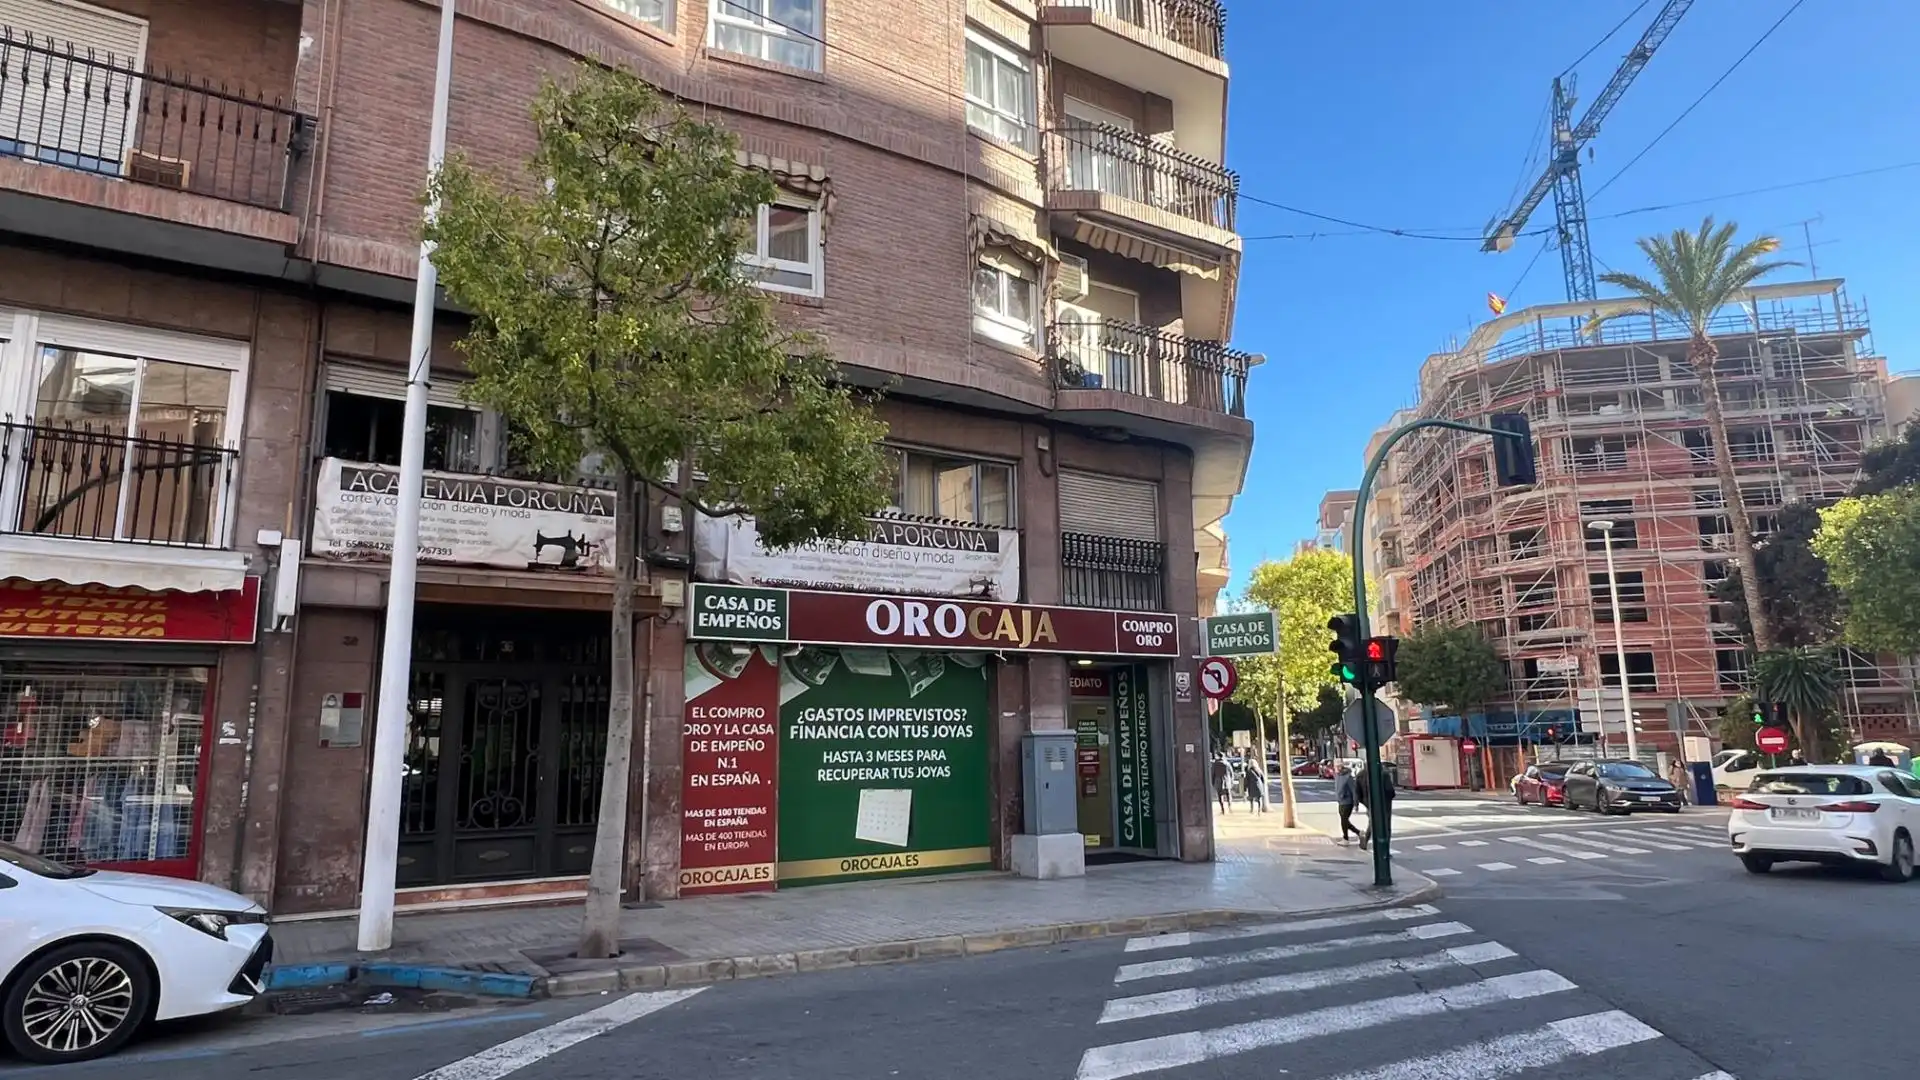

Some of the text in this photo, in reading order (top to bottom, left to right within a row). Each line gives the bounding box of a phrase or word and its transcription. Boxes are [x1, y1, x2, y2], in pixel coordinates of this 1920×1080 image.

[349, 470, 606, 515] ACAEMIA PORCUNA
[340, 492, 372, 504] corte
[375, 496, 381, 506] y
[491, 507, 498, 518] y
[499, 507, 531, 519] moda
[893, 524, 988, 551] PORCUNA
[872, 545, 910, 561] diseño
[914, 552, 921, 563] y
[923, 553, 955, 564] moda
[41, 596, 169, 610] TEXTIL
[704, 595, 777, 613] CASA DE
[698, 612, 782, 630] EMPEÑOS
[866, 599, 1058, 648] OROCAJA
[1121, 619, 1173, 634] COMPRO
[1214, 621, 1265, 635] CASA DE
[1135, 634, 1163, 647] ORO
[1211, 633, 1270, 649] EMPEÑOS
[692, 707, 765, 718] EL COMPRO
[797, 708, 967, 724] ¿GASTOS IMPREVISTOS?
[1138, 693, 1147, 737] MENOS
[713, 724, 722, 735] Y
[724, 724, 740, 735] LA
[742, 723, 774, 735] CASA
[790, 725, 973, 739] FINANCIA CON TUS JOYAS
[690, 738, 765, 752] DE EMPEÑO
[717, 757, 738, 769] N.1
[823, 749, 946, 764] HASTA 3 MESES PARA
[1117, 671, 1135, 840] CASA DE EMPEÑOS
[1140, 741, 1149, 786] TIEMPO
[691, 771, 760, 787] EN ESPAÑA
[817, 766, 951, 781] RECUPERAR TUS JOYAS
[705, 808, 716, 817] DE
[718, 808, 732, 816] 100
[733, 806, 767, 815] TIENDAS
[704, 816, 748, 827] EN ESPAÑA
[706, 832, 716, 841] DE
[718, 832, 733, 840] 400
[734, 830, 767, 839] TIENDAS
[704, 841, 750, 851] EN EUROPA
[840, 854, 919, 872] OROCAJA.ES
[680, 867, 769, 885] OROCAJA.ES
